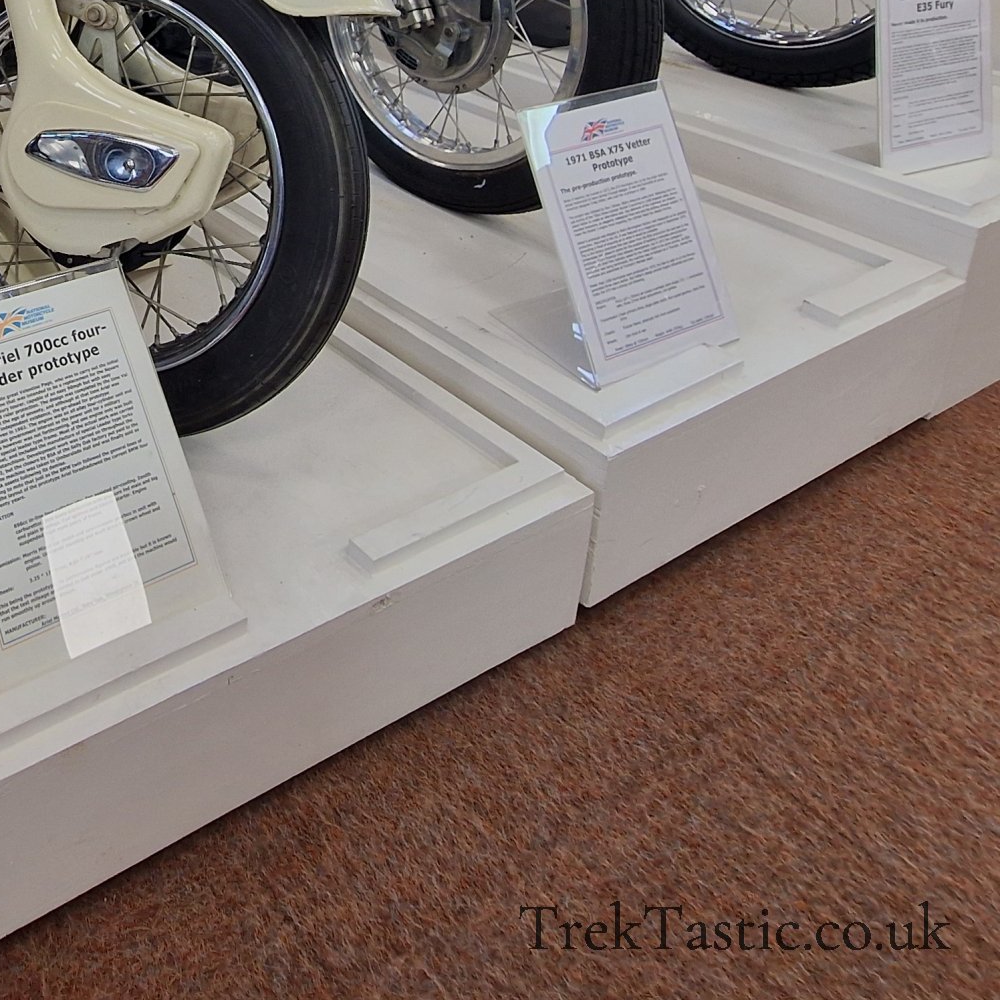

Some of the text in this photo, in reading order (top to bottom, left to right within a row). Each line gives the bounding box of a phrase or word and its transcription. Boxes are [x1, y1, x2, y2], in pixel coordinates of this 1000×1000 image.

[917, 0, 954, 12] E35 Fury
[565, 137, 651, 166] 1971 BSA X75 Vetter
[592, 155, 634, 172] Prototype
[571, 176, 611, 193] pre-production
[23, 335, 68, 357] 700cc
[71, 325, 106, 342] four-
[27, 345, 99, 379] prototype
